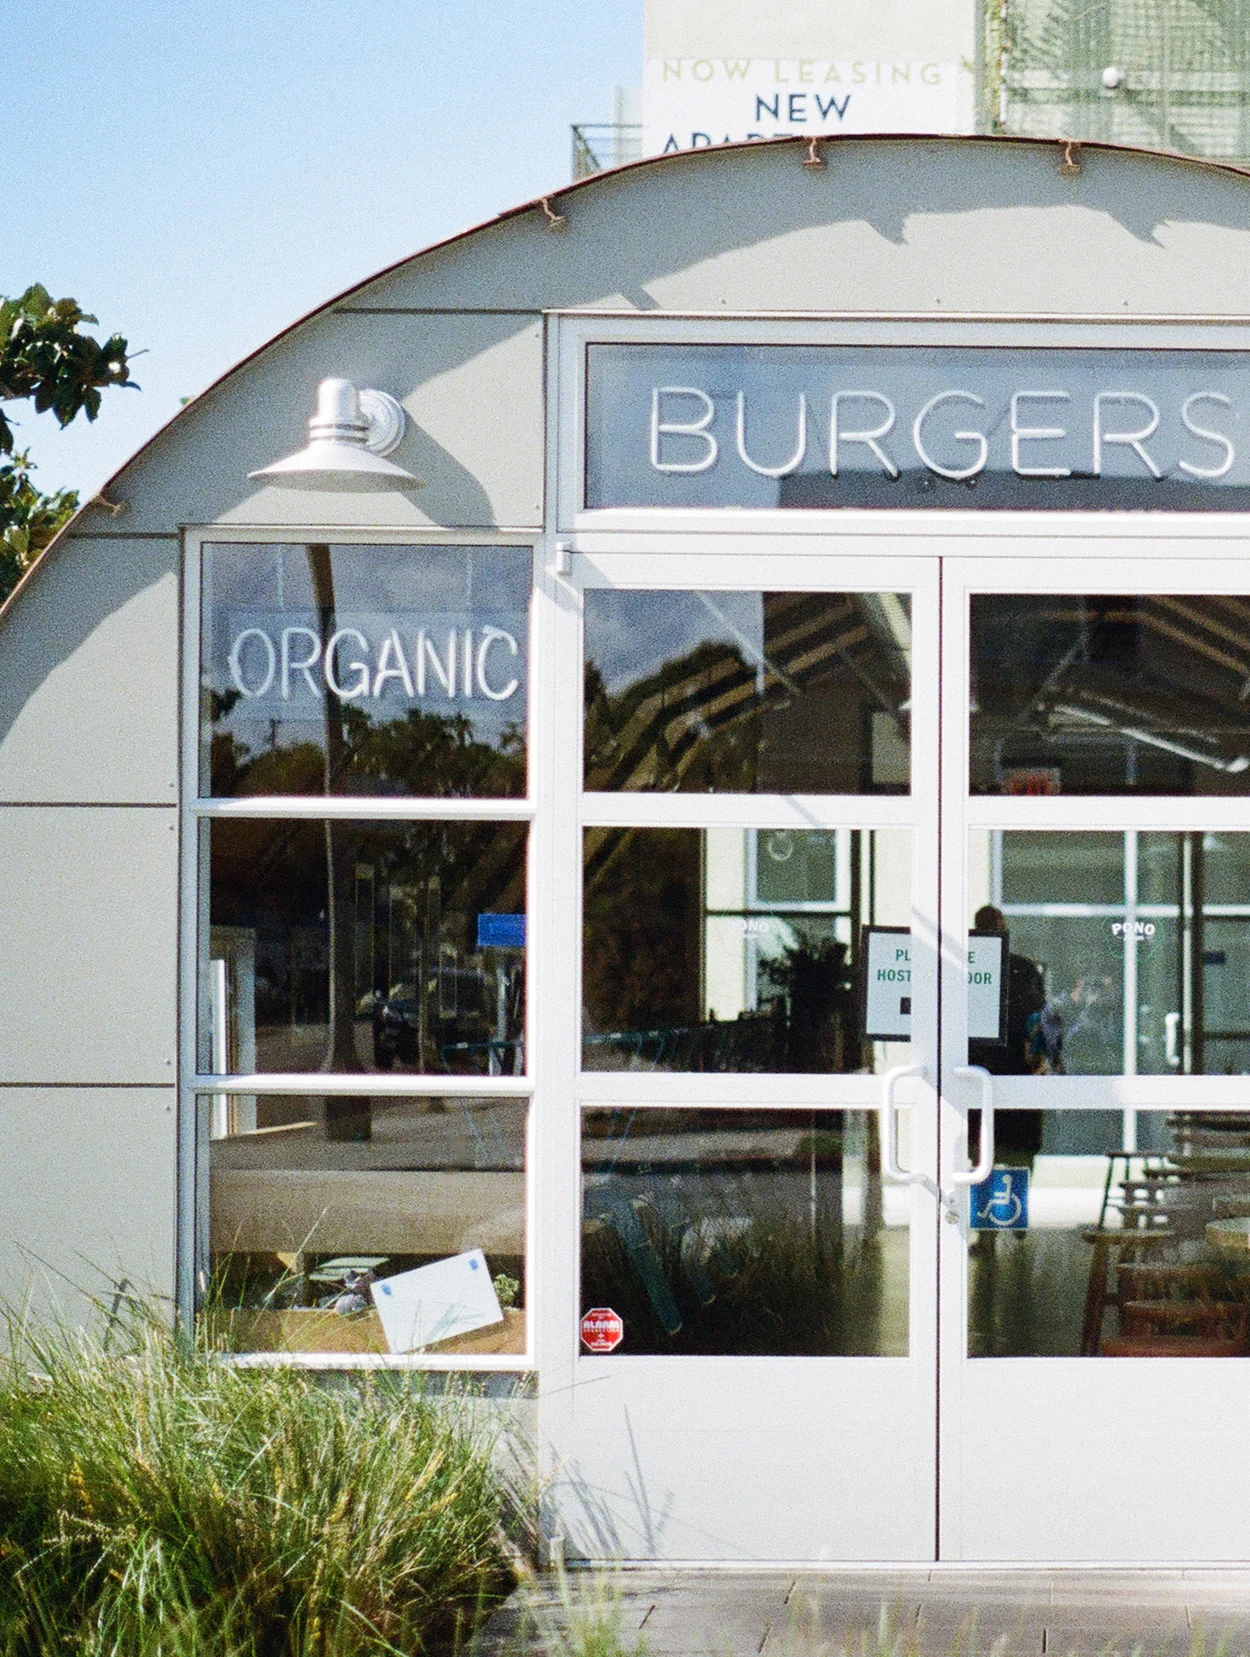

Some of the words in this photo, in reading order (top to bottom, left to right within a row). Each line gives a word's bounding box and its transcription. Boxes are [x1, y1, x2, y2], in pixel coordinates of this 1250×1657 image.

[662, 58, 750, 82] NOW
[774, 61, 942, 86] LEASING
[755, 94, 851, 122] NEW
[650, 386, 1235, 479] BURGERS
[228, 625, 518, 700] ORGANIC
[1111, 922, 1155, 935] PONO
